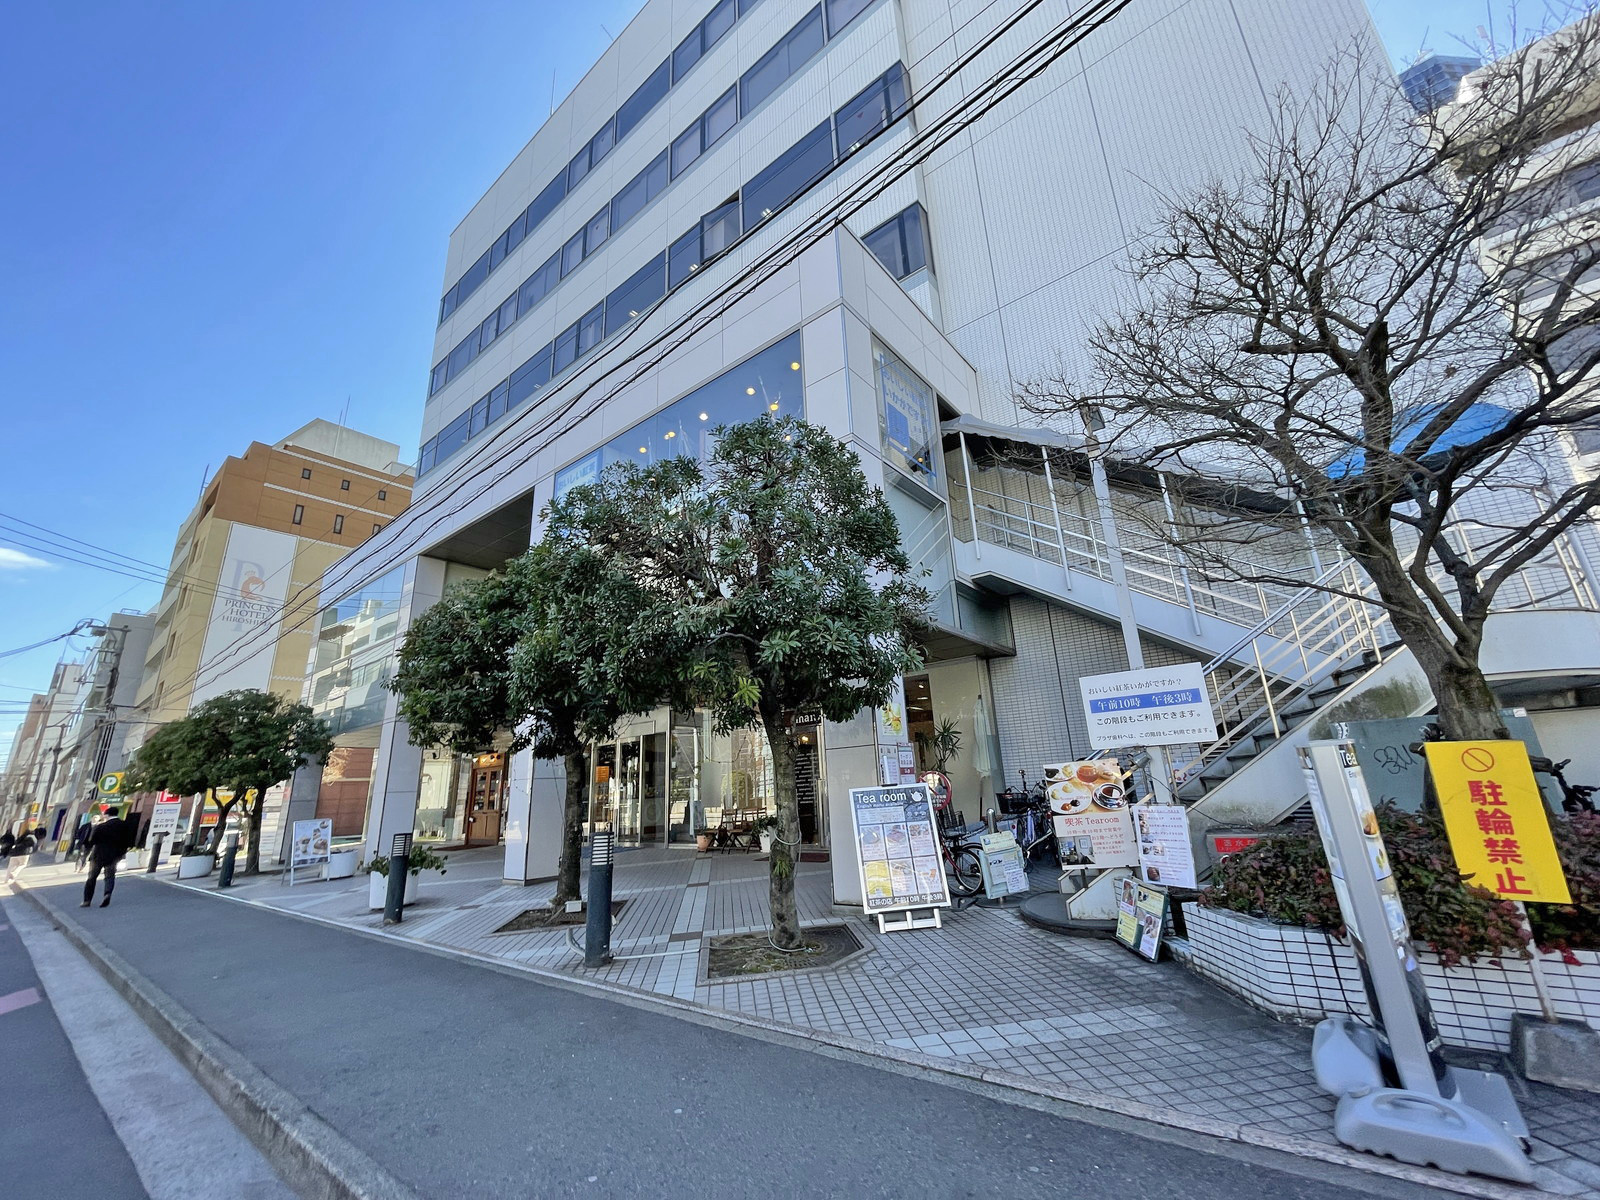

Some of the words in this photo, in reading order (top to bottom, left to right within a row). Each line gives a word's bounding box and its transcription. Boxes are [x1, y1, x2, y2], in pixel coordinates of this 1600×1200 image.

[225, 599, 278, 613] PRINCESS
[230, 608, 266, 619] HOTEL
[1097, 697, 1140, 711] 午前10時
[1152, 691, 1192, 705] 午後3時
[1096, 709, 1201, 726] この階段もご利用できます。
[1339, 749, 1358, 767] Tea
[104, 776, 117, 790] P
[856, 793, 876, 804] Tea
[879, 792, 907, 803] room
[1064, 817, 1084, 827] 喫茶
[1085, 816, 1120, 825] Tearoom
[1467, 780, 1533, 895] 駐輪禁止
